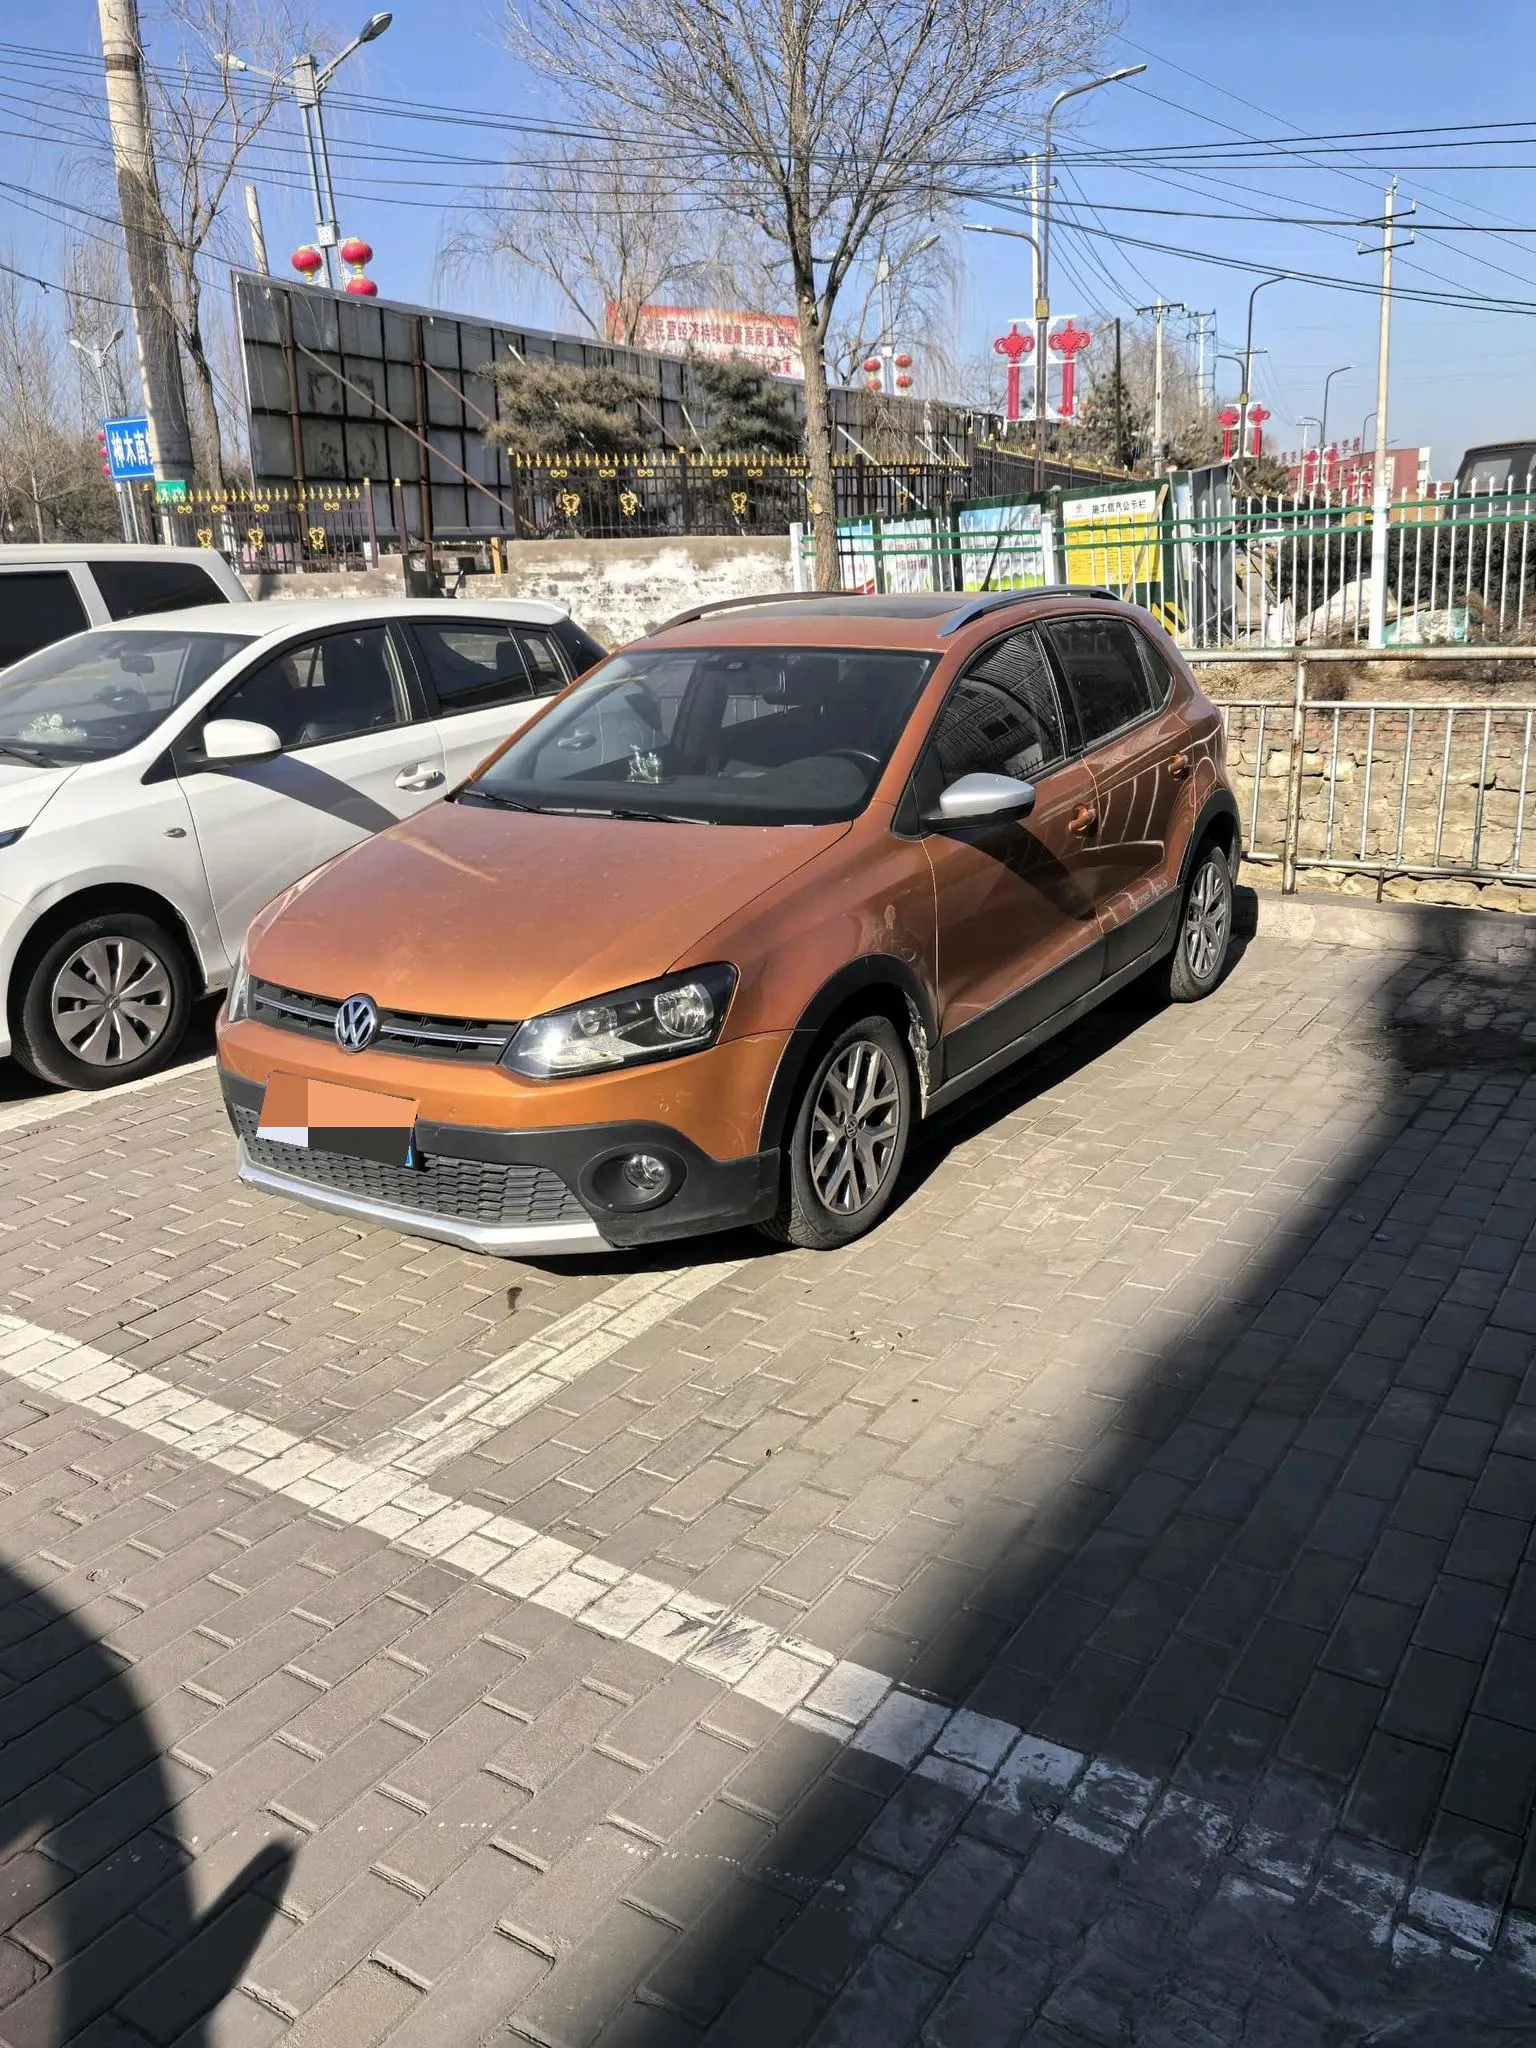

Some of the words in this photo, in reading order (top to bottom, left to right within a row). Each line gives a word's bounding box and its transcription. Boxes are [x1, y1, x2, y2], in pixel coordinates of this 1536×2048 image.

[111, 428, 153, 469] 神木南
[335, 994, 377, 1052] VW
